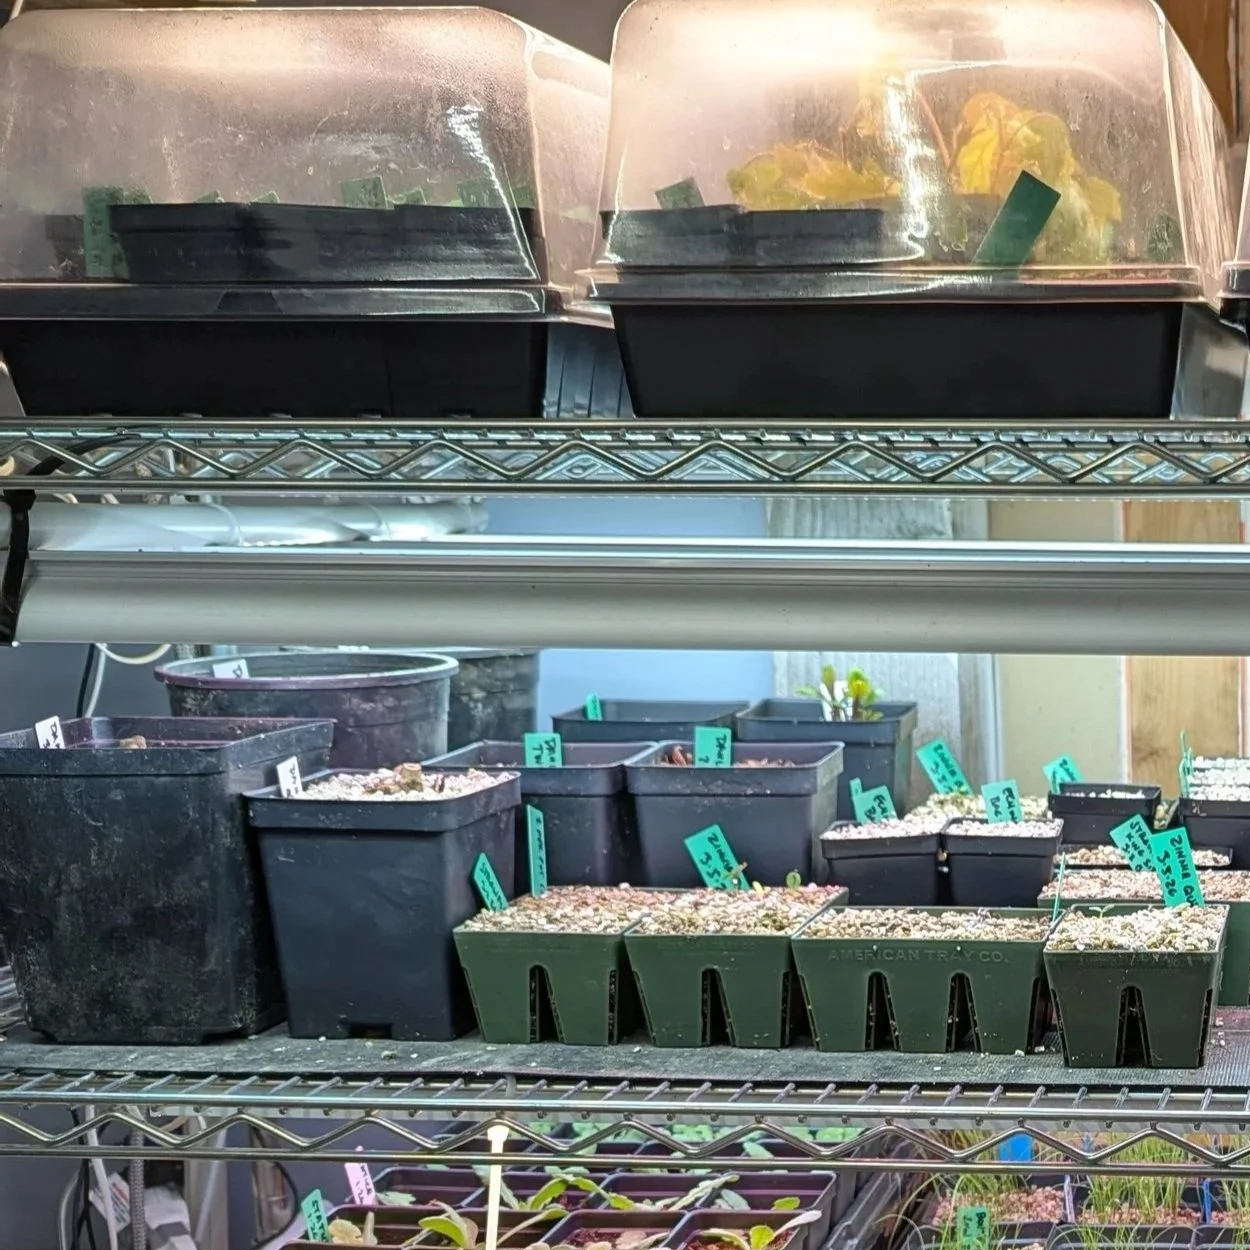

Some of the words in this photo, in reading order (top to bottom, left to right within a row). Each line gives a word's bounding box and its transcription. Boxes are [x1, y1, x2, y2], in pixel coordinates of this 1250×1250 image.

[827, 948, 920, 962] AMERICAN
[927, 949, 977, 962] TRAY
[978, 951, 1010, 964] CO.
